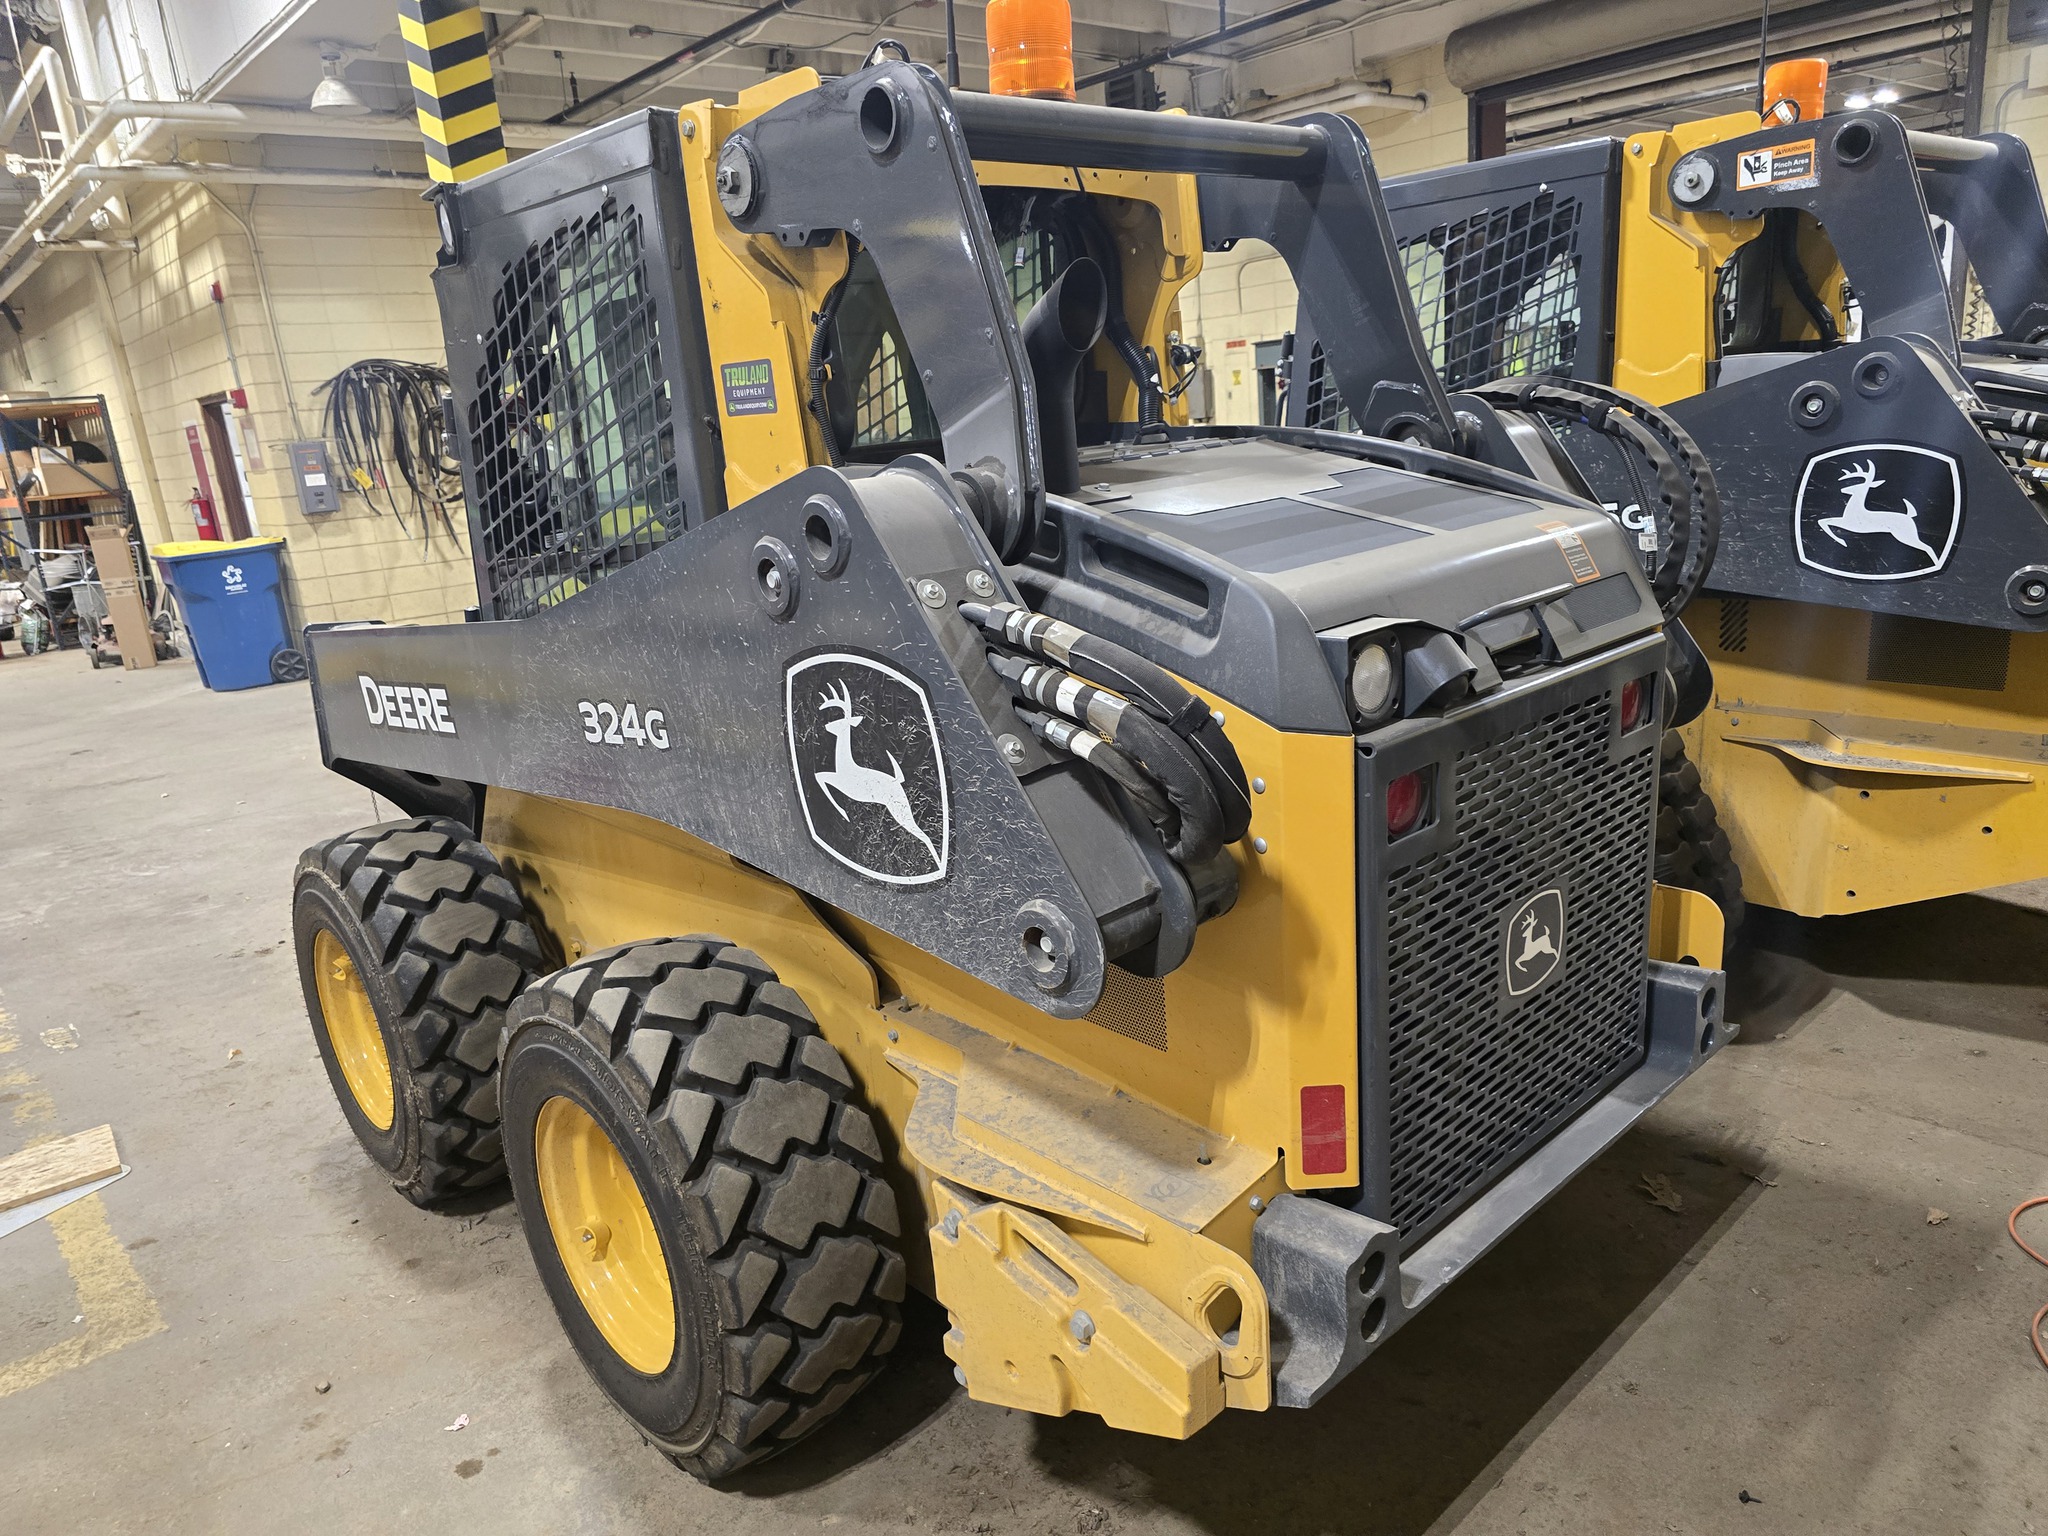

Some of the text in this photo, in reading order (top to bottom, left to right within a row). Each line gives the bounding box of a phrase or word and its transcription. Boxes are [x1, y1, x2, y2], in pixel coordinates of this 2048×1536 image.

[1782, 144, 1811, 154] WARNING
[1773, 158, 1809, 170] Pinch Area
[724, 364, 768, 387] TRULAND
[733, 387, 766, 397] EQUIPMENT
[358, 675, 456, 733] DEERE
[578, 701, 670, 749] 324G
